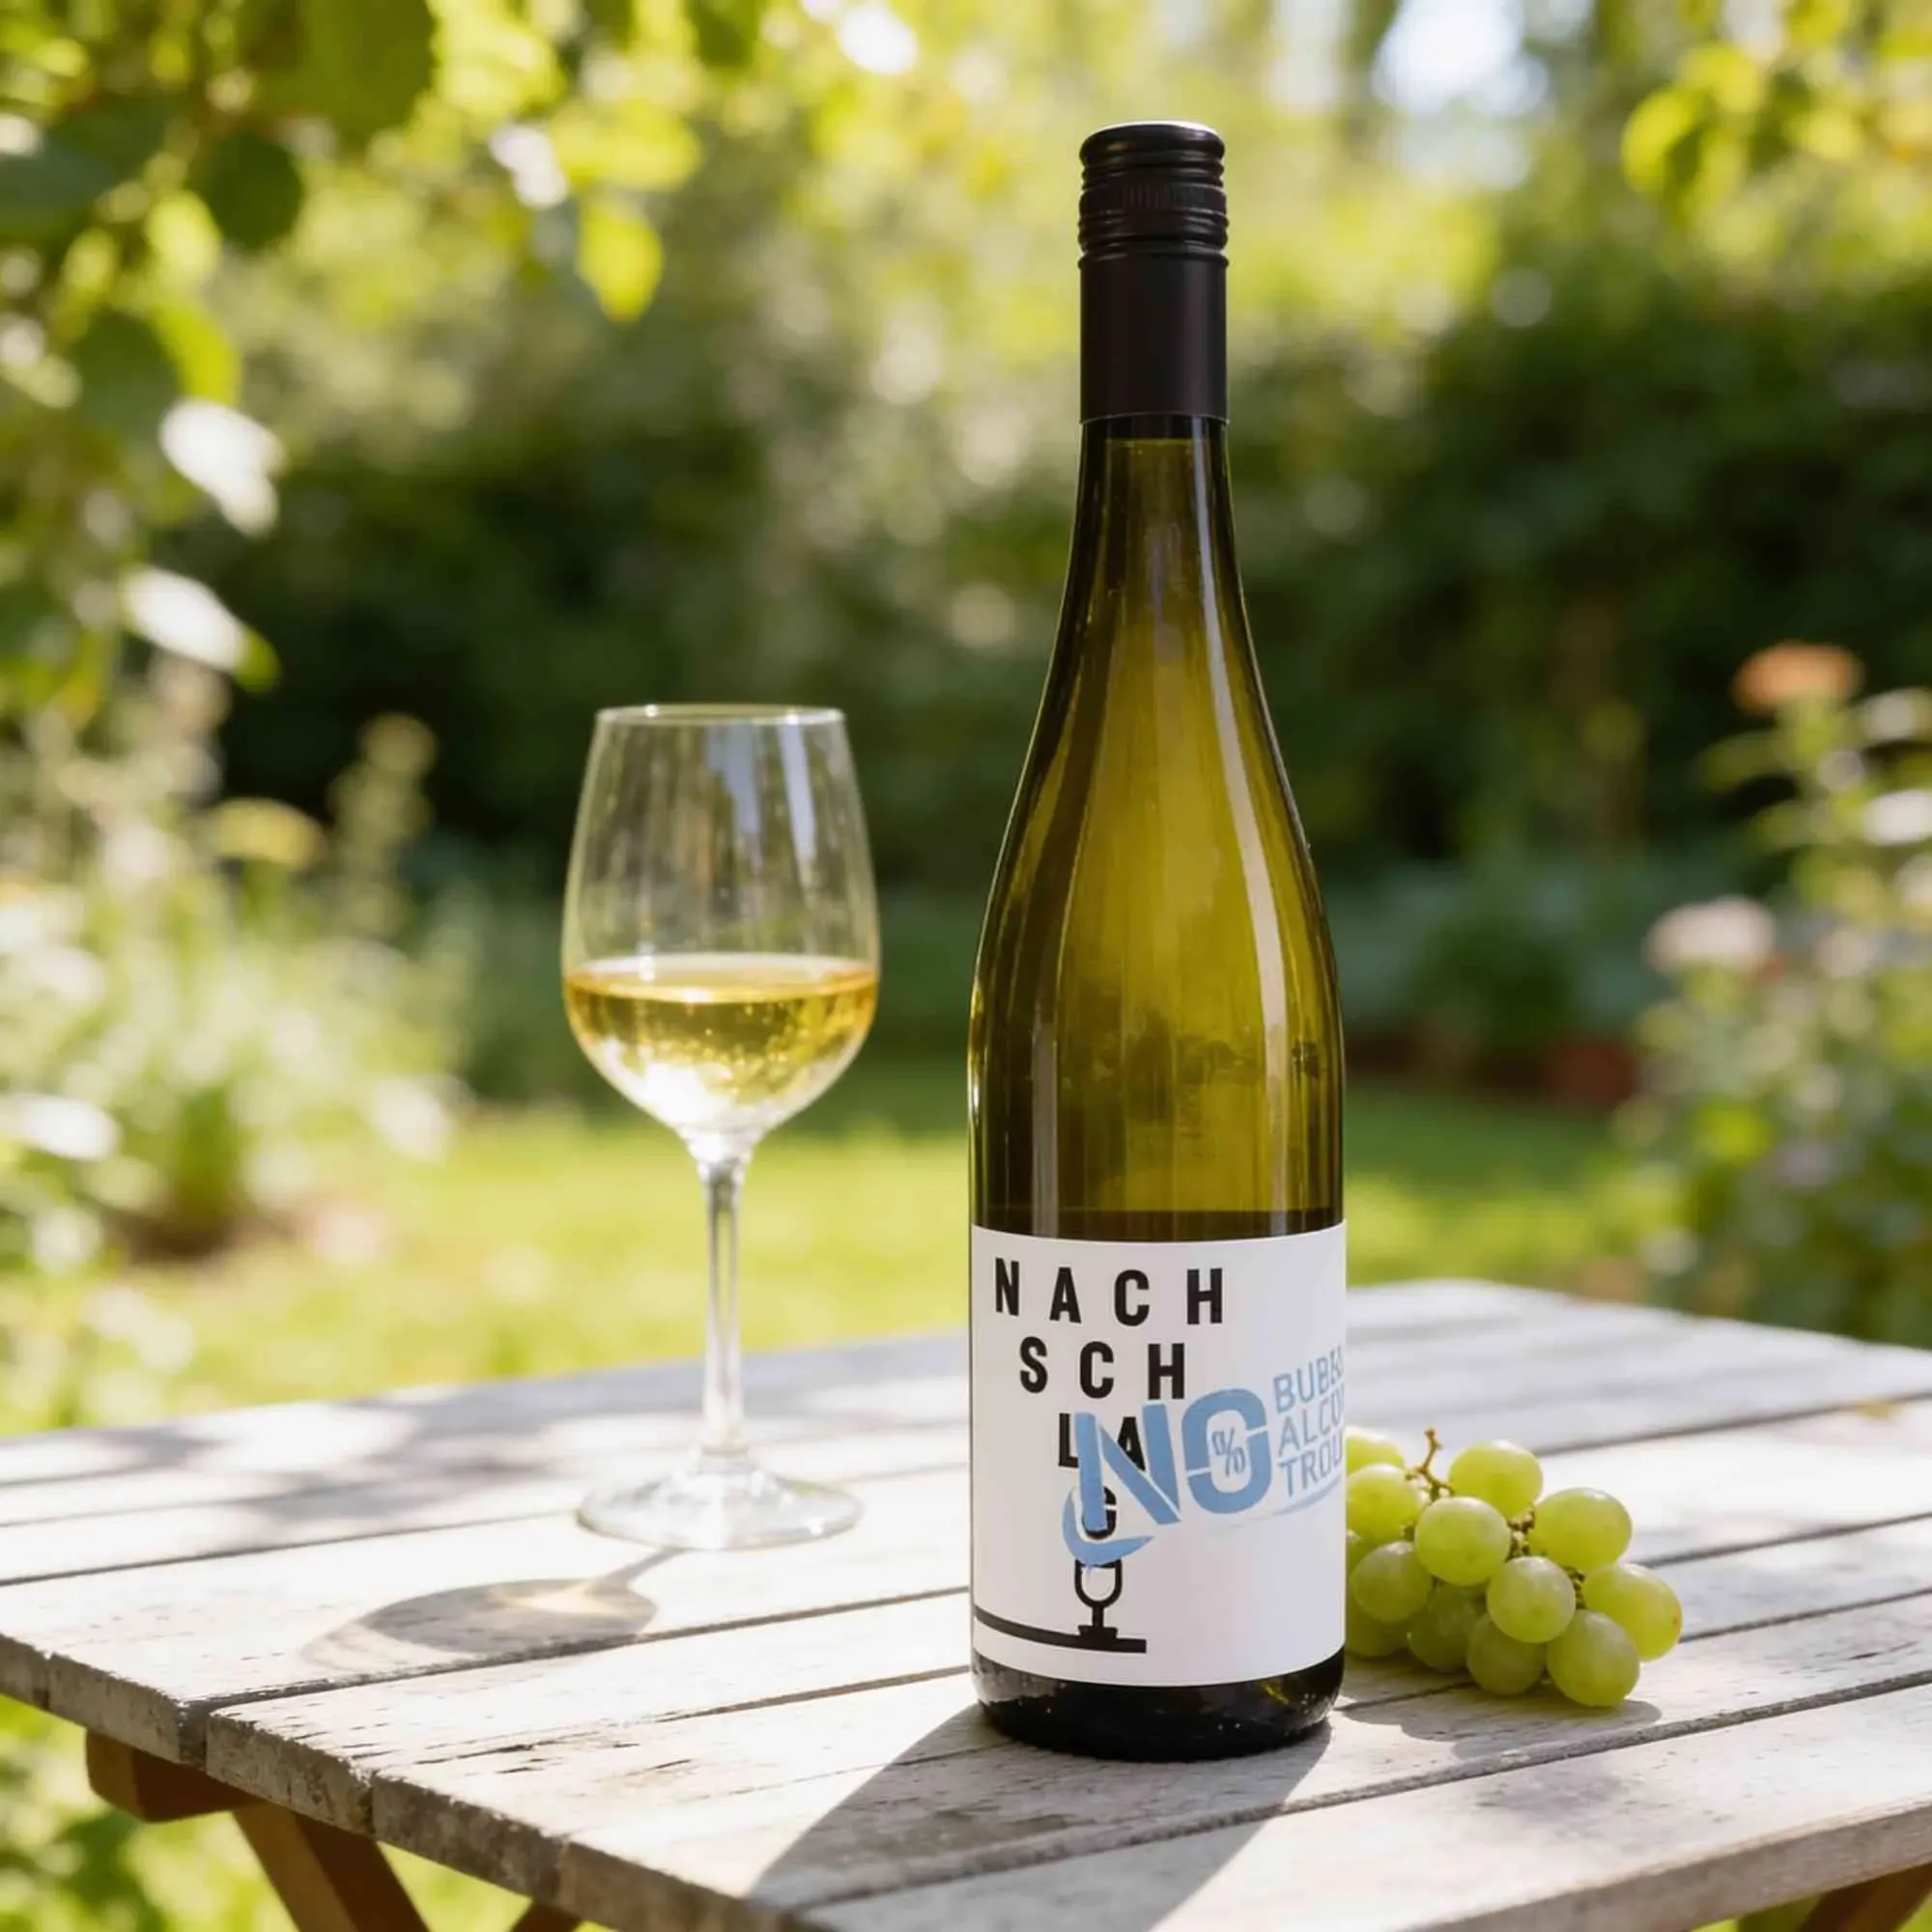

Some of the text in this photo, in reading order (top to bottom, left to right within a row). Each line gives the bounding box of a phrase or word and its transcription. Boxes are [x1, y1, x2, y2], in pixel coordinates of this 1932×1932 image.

[995, 1257, 1223, 1326] NACH
[1019, 1336, 1185, 1400] SCH
[1074, 1387, 1271, 1525] NO
